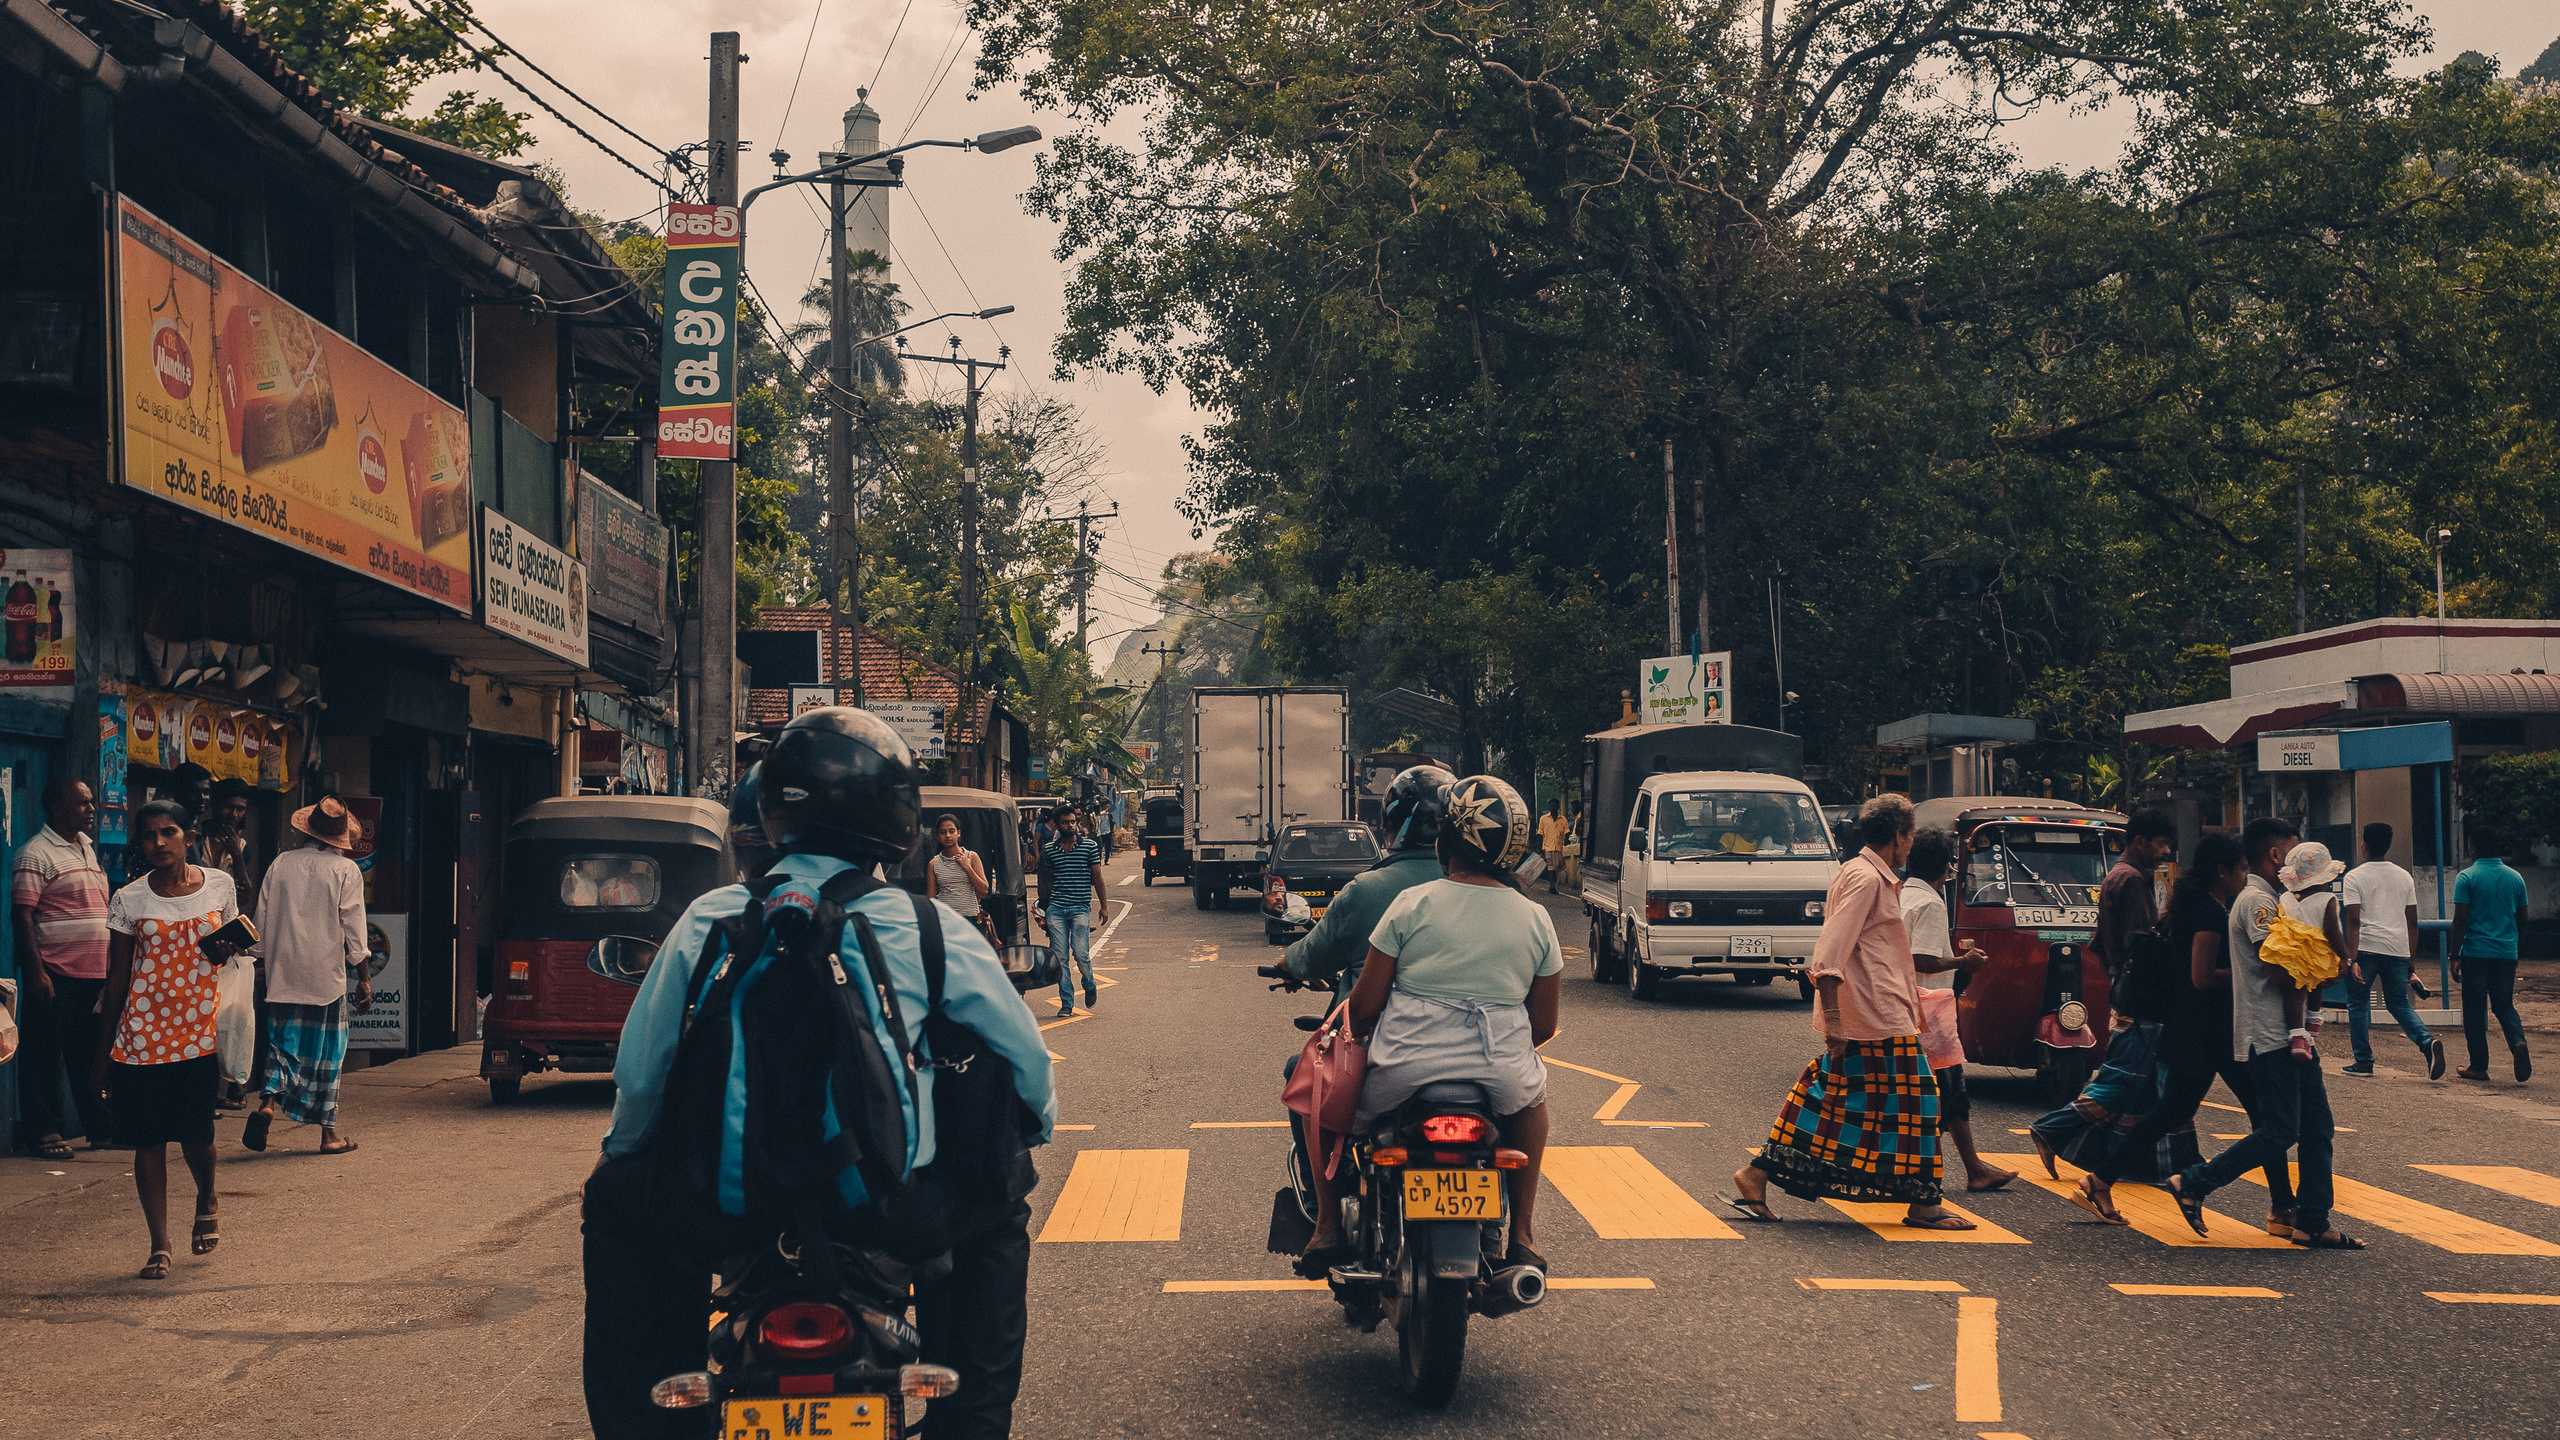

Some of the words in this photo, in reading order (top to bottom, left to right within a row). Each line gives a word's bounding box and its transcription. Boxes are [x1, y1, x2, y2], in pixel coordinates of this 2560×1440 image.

[489, 576, 510, 610] SEW
[511, 585, 566, 633] GUNASEKARA
[2300, 742, 2315, 750] AUTO
[2284, 752, 2313, 766] DIESEL
[2032, 911, 2053, 923] GU
[2070, 911, 2099, 924] 239
[2253, 908, 2272, 928] 2
[348, 1020, 401, 1029] UNASEKARA
[1437, 1172, 1468, 1193] MU
[1435, 1196, 1486, 1216] 4597
[783, 1402, 832, 1437] WE
